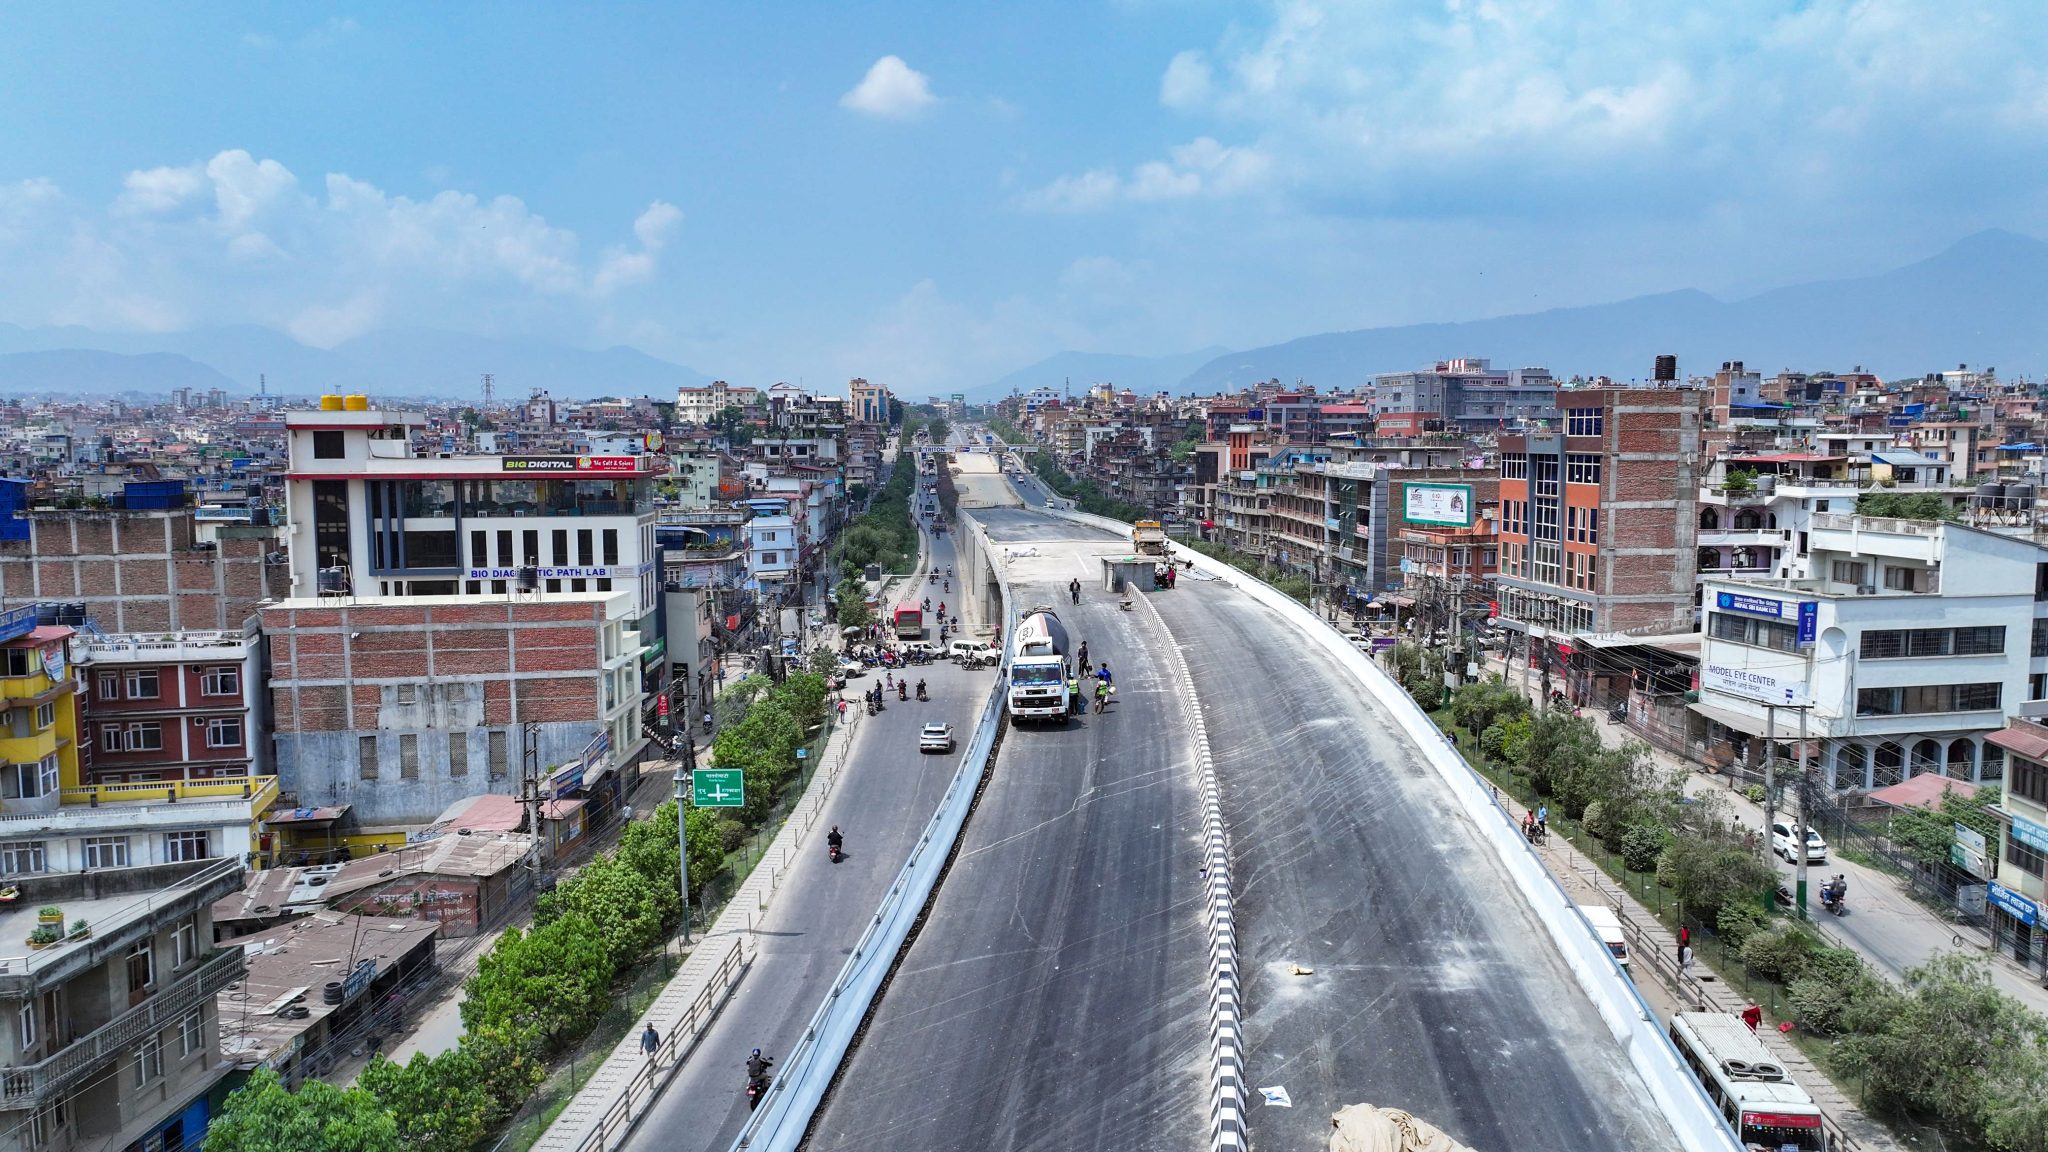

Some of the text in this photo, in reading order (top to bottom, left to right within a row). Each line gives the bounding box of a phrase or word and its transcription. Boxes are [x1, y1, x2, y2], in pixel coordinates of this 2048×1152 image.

[505, 461, 573, 469] BIG DIGITAL
[471, 570, 488, 578] BIO
[492, 569, 553, 578] DIAGTIC
[557, 568, 582, 577] PATH
[586, 568, 606, 576] LAB
[1734, 602, 1748, 610] NEPAL
[1708, 665, 1776, 687] MODEL EYE CENTER
